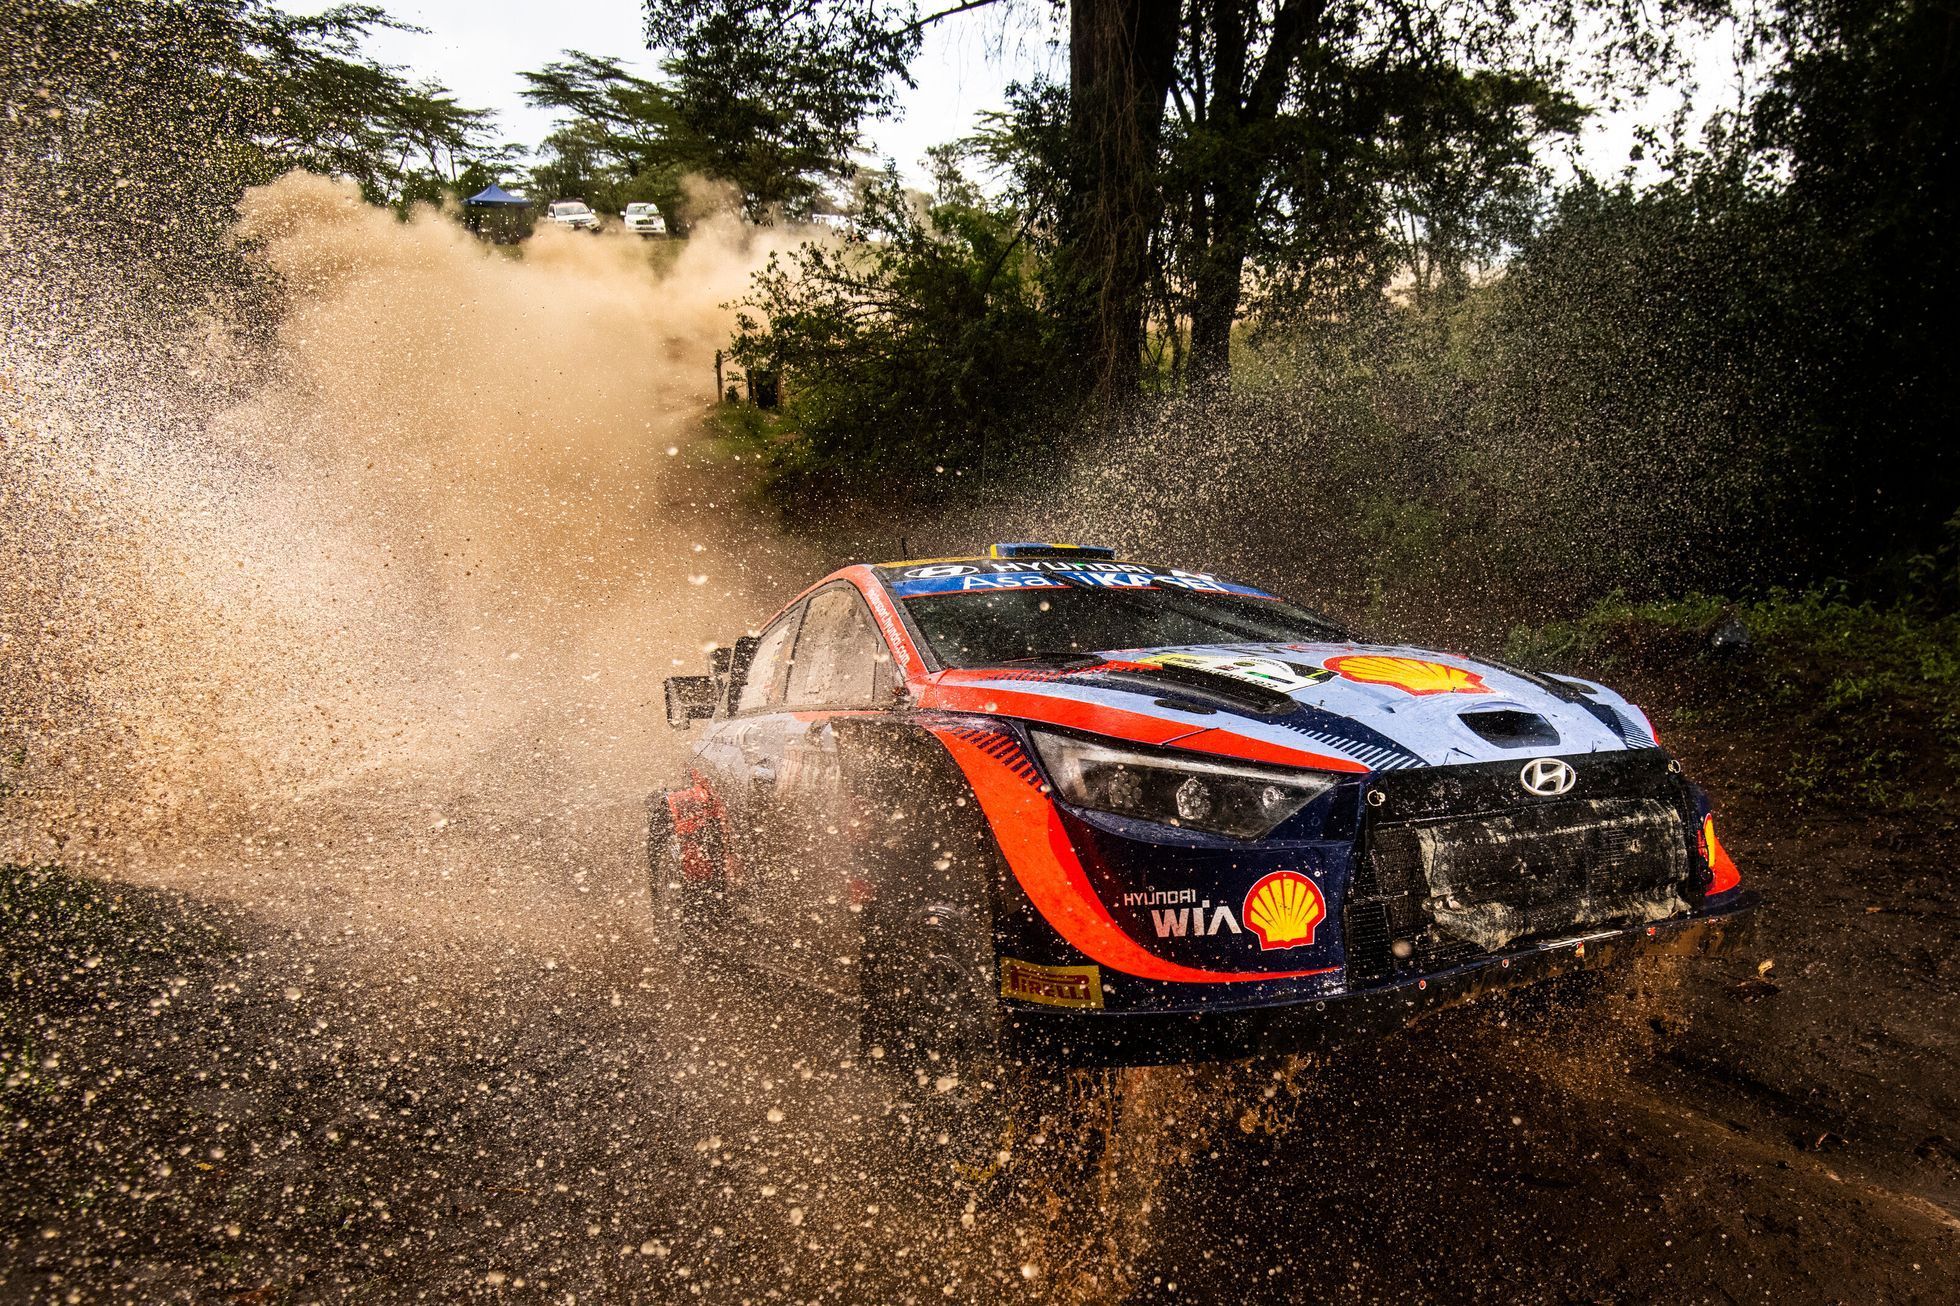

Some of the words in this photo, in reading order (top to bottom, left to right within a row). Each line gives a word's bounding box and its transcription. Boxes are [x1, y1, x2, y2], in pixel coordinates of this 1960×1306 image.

[991, 561, 1155, 575] HYUNDAI
[1123, 888, 1197, 906] HYUNDAI
[1009, 965, 1092, 1000] PIRELLI
